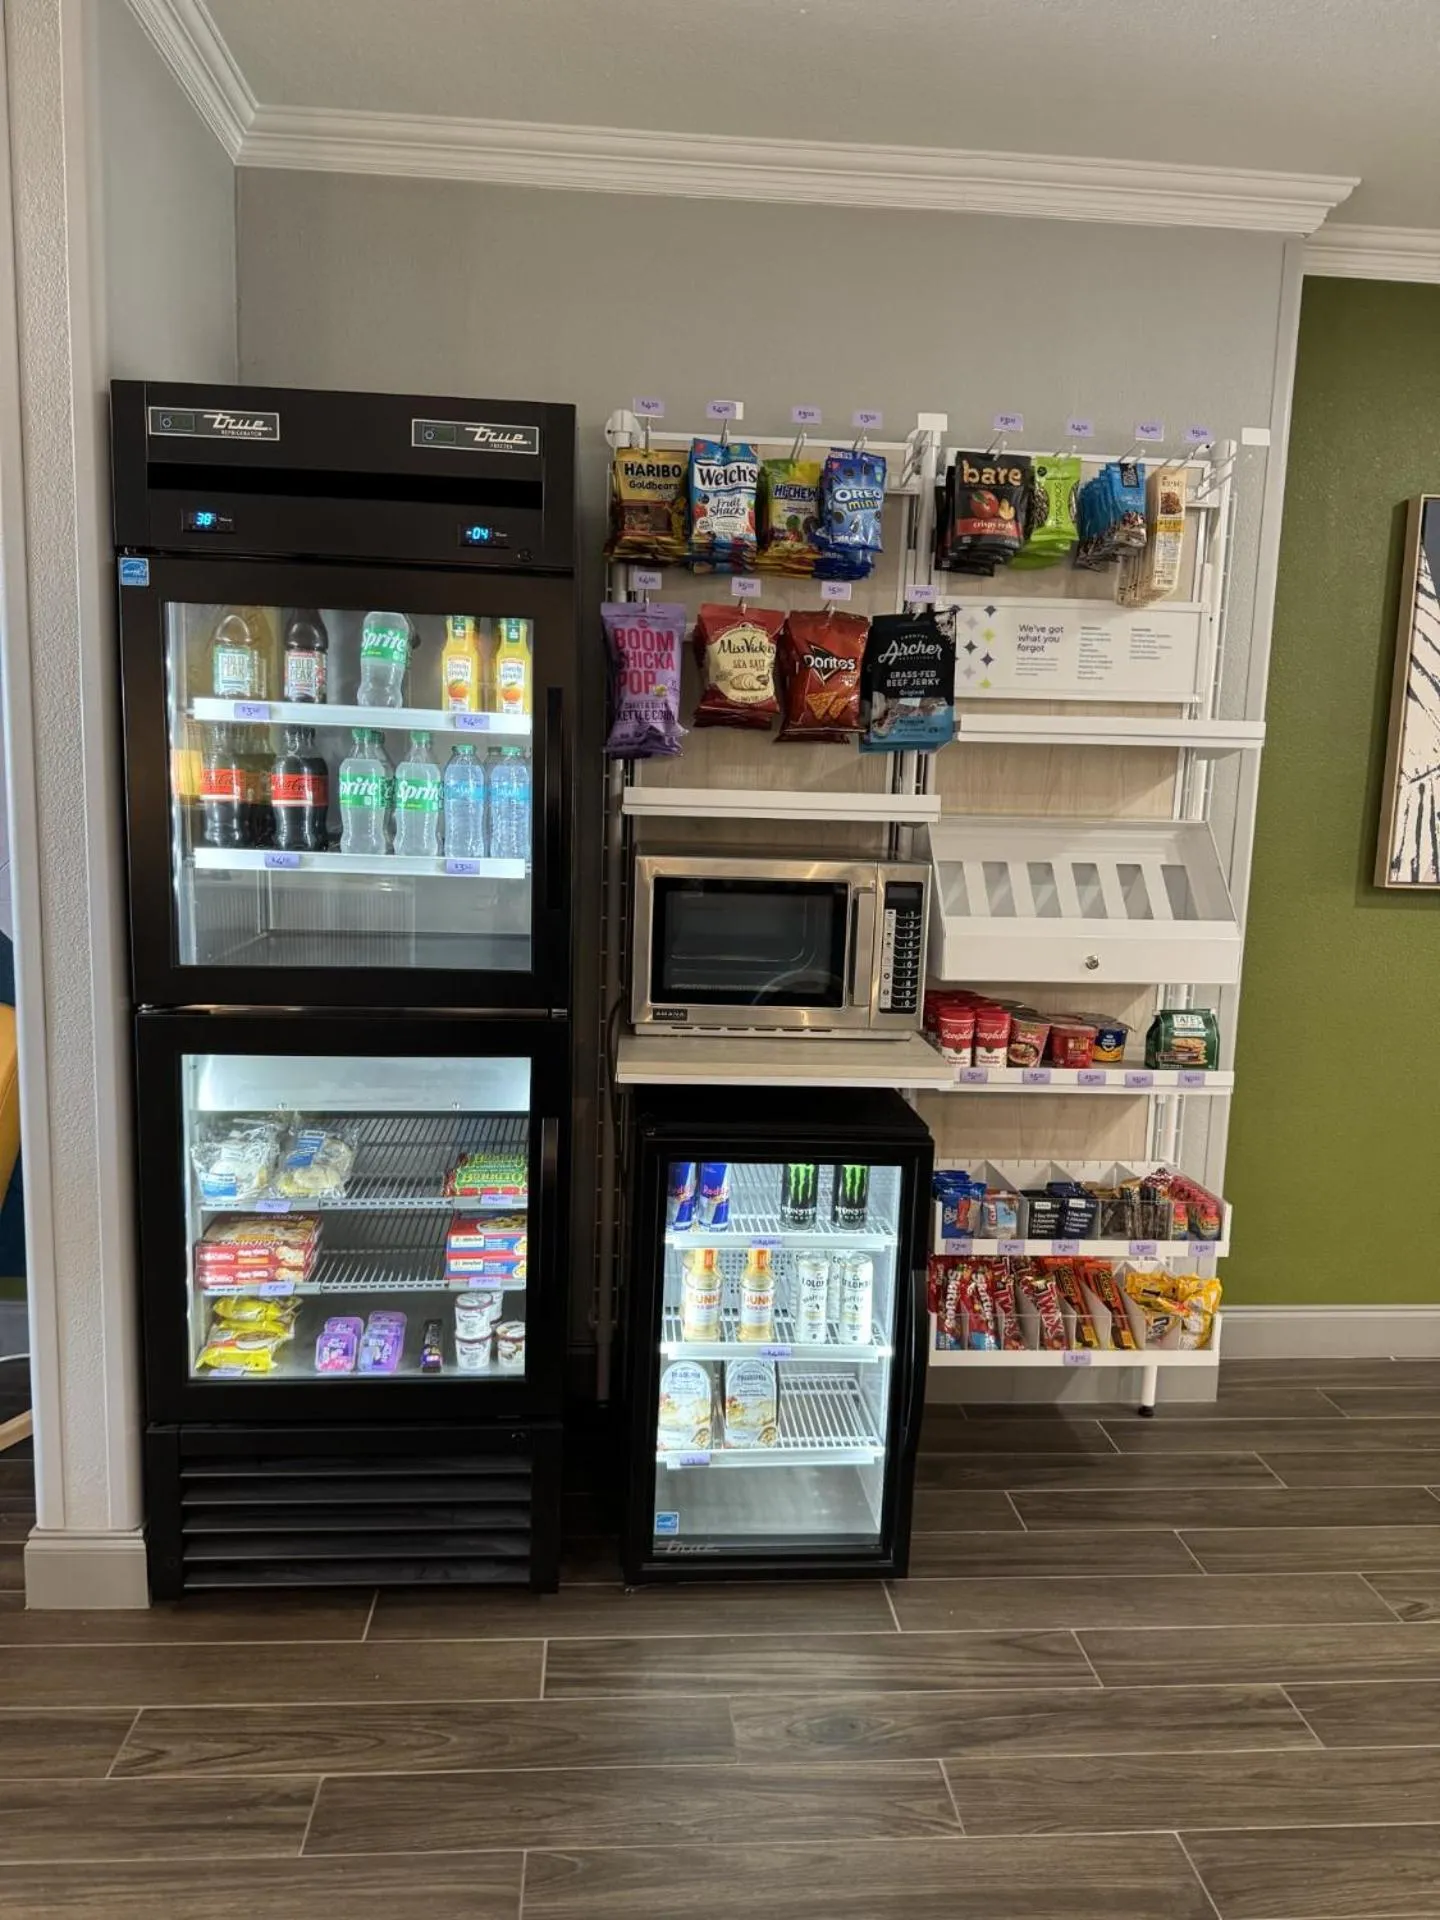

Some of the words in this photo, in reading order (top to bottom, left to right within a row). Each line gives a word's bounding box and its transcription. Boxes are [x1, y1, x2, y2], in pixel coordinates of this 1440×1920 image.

[624, 463, 682, 478] HARIBO
[697, 465, 757, 487] Welch's
[962, 460, 1022, 486] bare
[629, 480, 680, 491] Goldbears
[835, 490, 881, 501] OREO
[717, 498, 741, 508] Fruit
[709, 504, 747, 518] Snacks
[196, 512, 212, 526] 38
[1018, 624, 1047, 633] We've
[1048, 625, 1064, 634] got
[361, 627, 407, 651] Sprite
[614, 627, 675, 652] BOOM
[1018, 634, 1041, 643] what
[1043, 636, 1060, 644] you
[878, 640, 943, 666] Archer
[1016, 643, 1045, 653] forgot
[617, 651, 675, 672] CHICKA
[803, 654, 856, 670] Doritos
[890, 670, 937, 679] GRASS-FED
[615, 669, 658, 697] POP
[886, 679, 909, 688] BEEF
[911, 678, 941, 687] JERKY
[617, 709, 650, 723] KETTLE
[1034, 1280, 1066, 1338] TWIX
